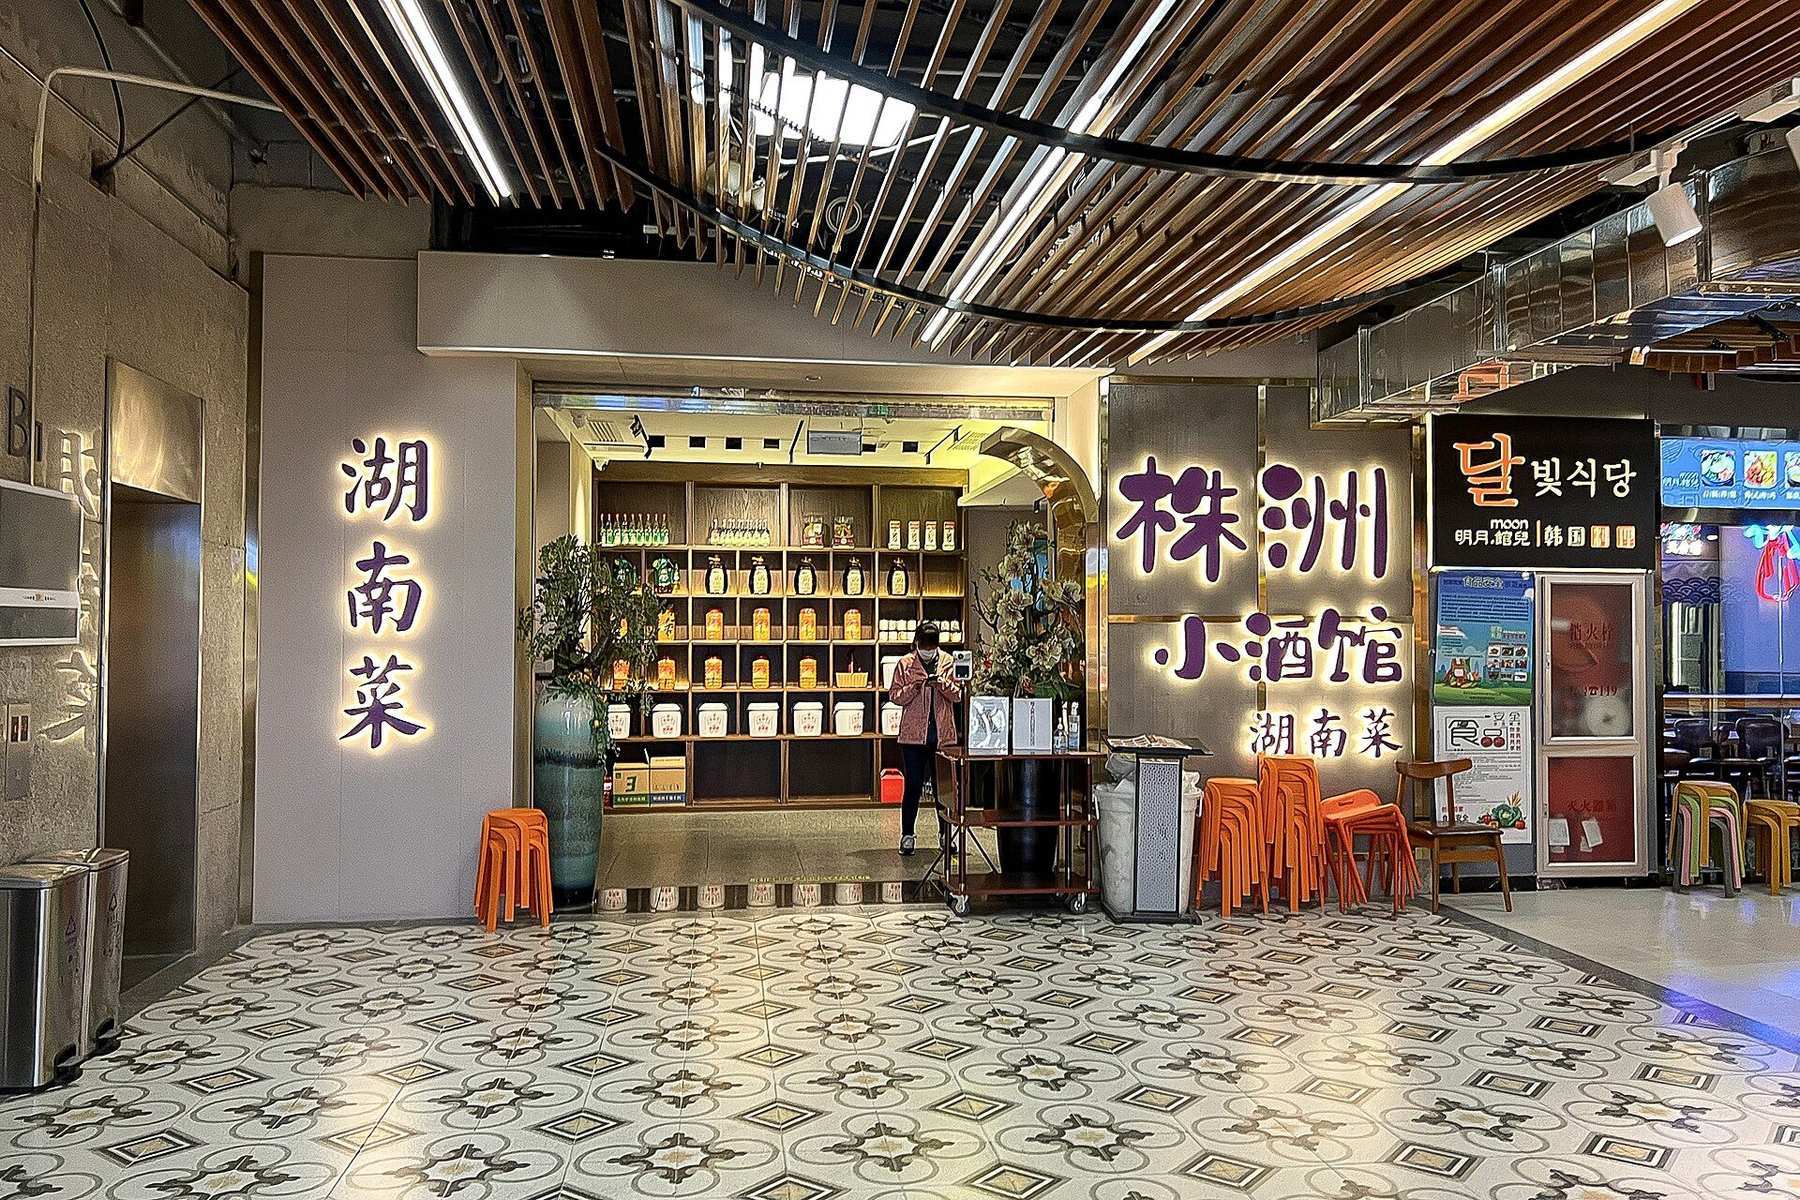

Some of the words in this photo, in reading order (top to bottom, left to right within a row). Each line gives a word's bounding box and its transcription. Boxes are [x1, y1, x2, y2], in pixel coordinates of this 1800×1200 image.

[1116, 456, 1388, 583] 株洲
[1490, 518, 1529, 530] moon
[340, 436, 430, 750] 湖南菜
[1154, 606, 1403, 683] 小酒馆
[1250, 708, 1403, 758] 湖南菜
